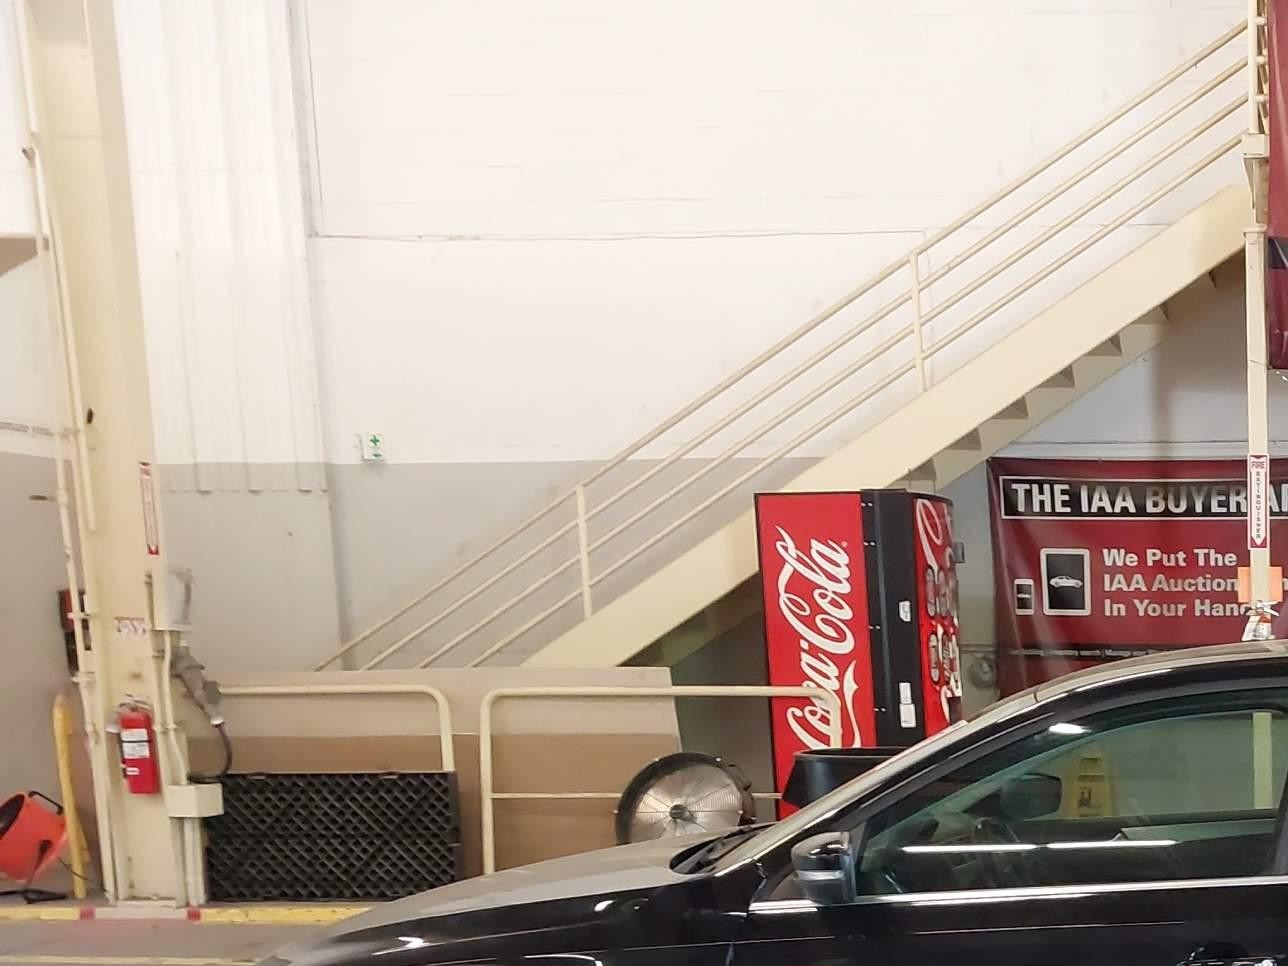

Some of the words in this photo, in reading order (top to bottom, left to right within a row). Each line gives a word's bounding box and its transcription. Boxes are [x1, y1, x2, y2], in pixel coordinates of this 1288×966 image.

[1011, 484, 1070, 513] THE
[1080, 484, 1137, 513] IAA
[1145, 486, 1248, 513] BUYER
[1102, 548, 1138, 567] We
[1146, 549, 1187, 567] Put
[1193, 548, 1237, 567] The
[1103, 574, 1148, 592] IAA
[1152, 574, 1238, 592] Auction
[1104, 599, 1126, 617] In
[1134, 599, 1186, 617] Your
